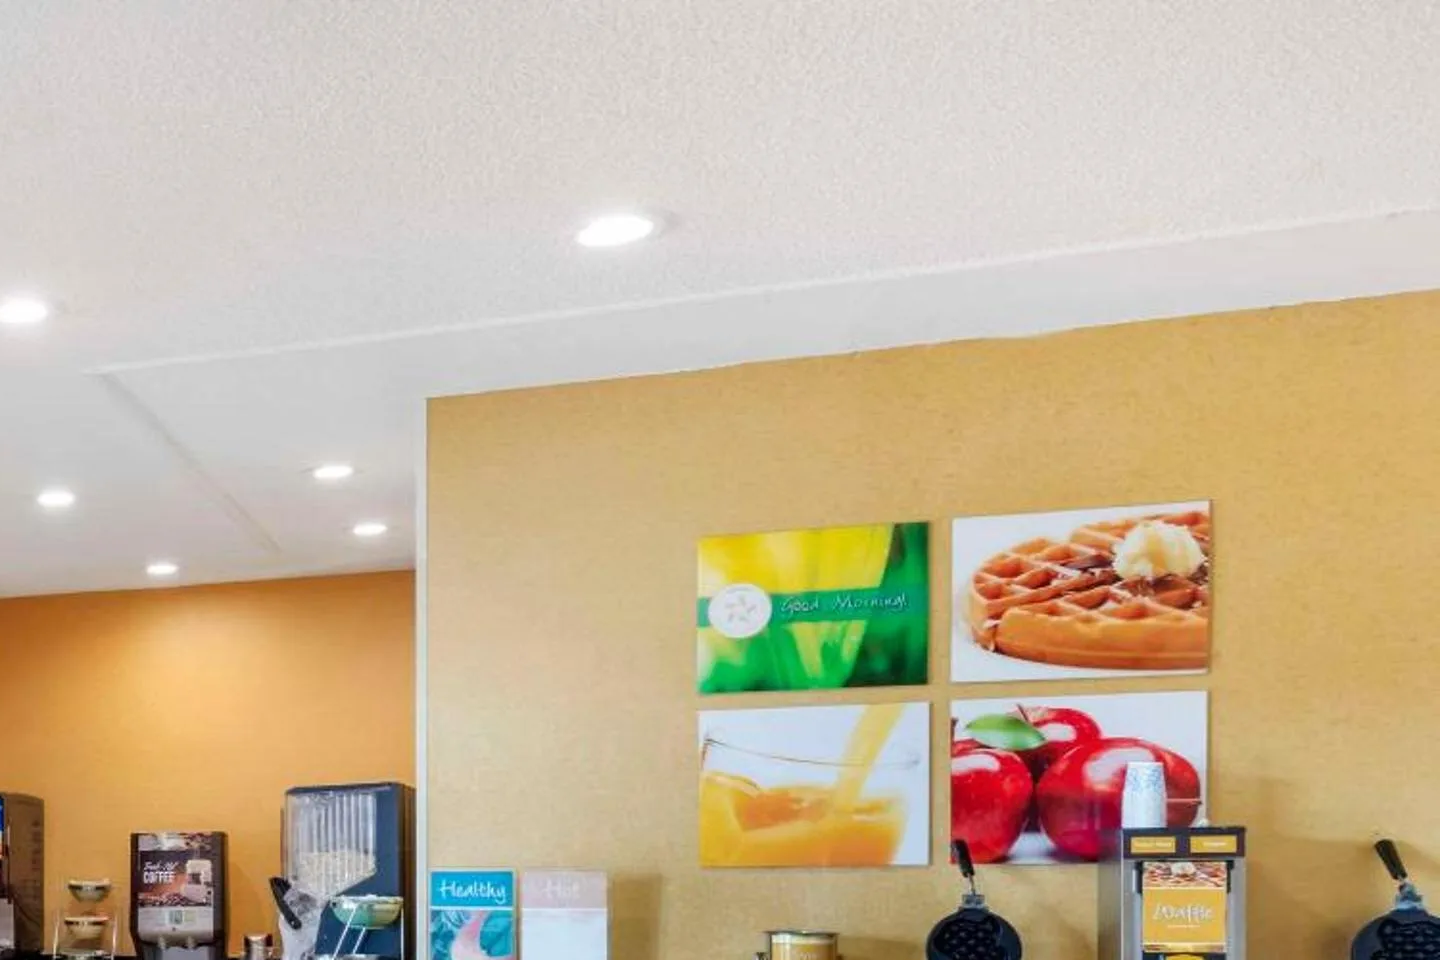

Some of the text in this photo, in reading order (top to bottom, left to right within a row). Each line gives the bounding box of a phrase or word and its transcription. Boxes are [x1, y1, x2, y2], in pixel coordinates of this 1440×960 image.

[780, 594, 819, 616] Good
[439, 878, 507, 905] Healthy
[1152, 903, 1215, 925] Waffle
